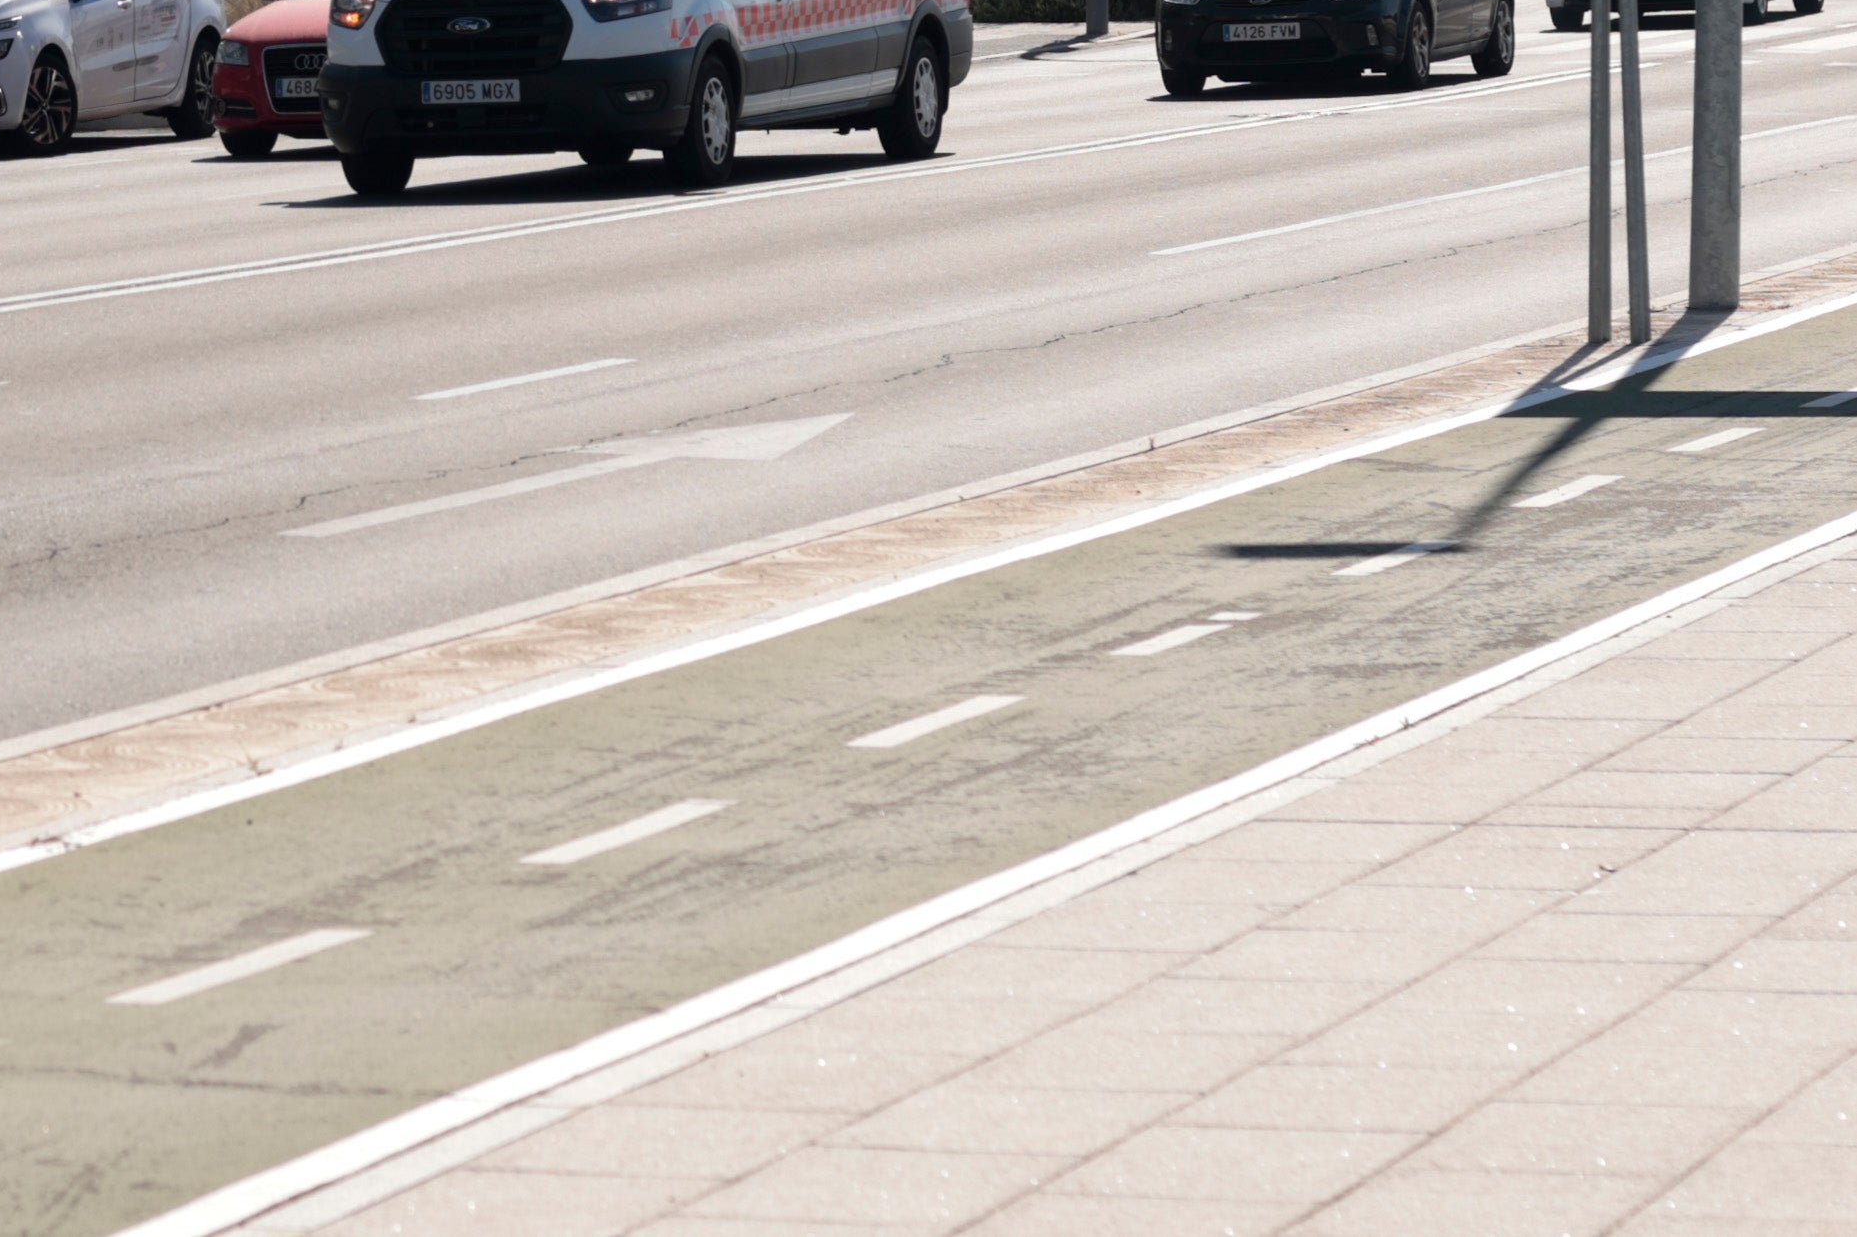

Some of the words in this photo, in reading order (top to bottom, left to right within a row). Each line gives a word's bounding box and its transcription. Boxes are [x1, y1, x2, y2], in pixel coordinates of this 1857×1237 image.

[1233, 26, 1265, 39] 4126
[1271, 25, 1296, 38] FVM
[433, 83, 475, 100] 6905
[482, 82, 514, 99] MGX
